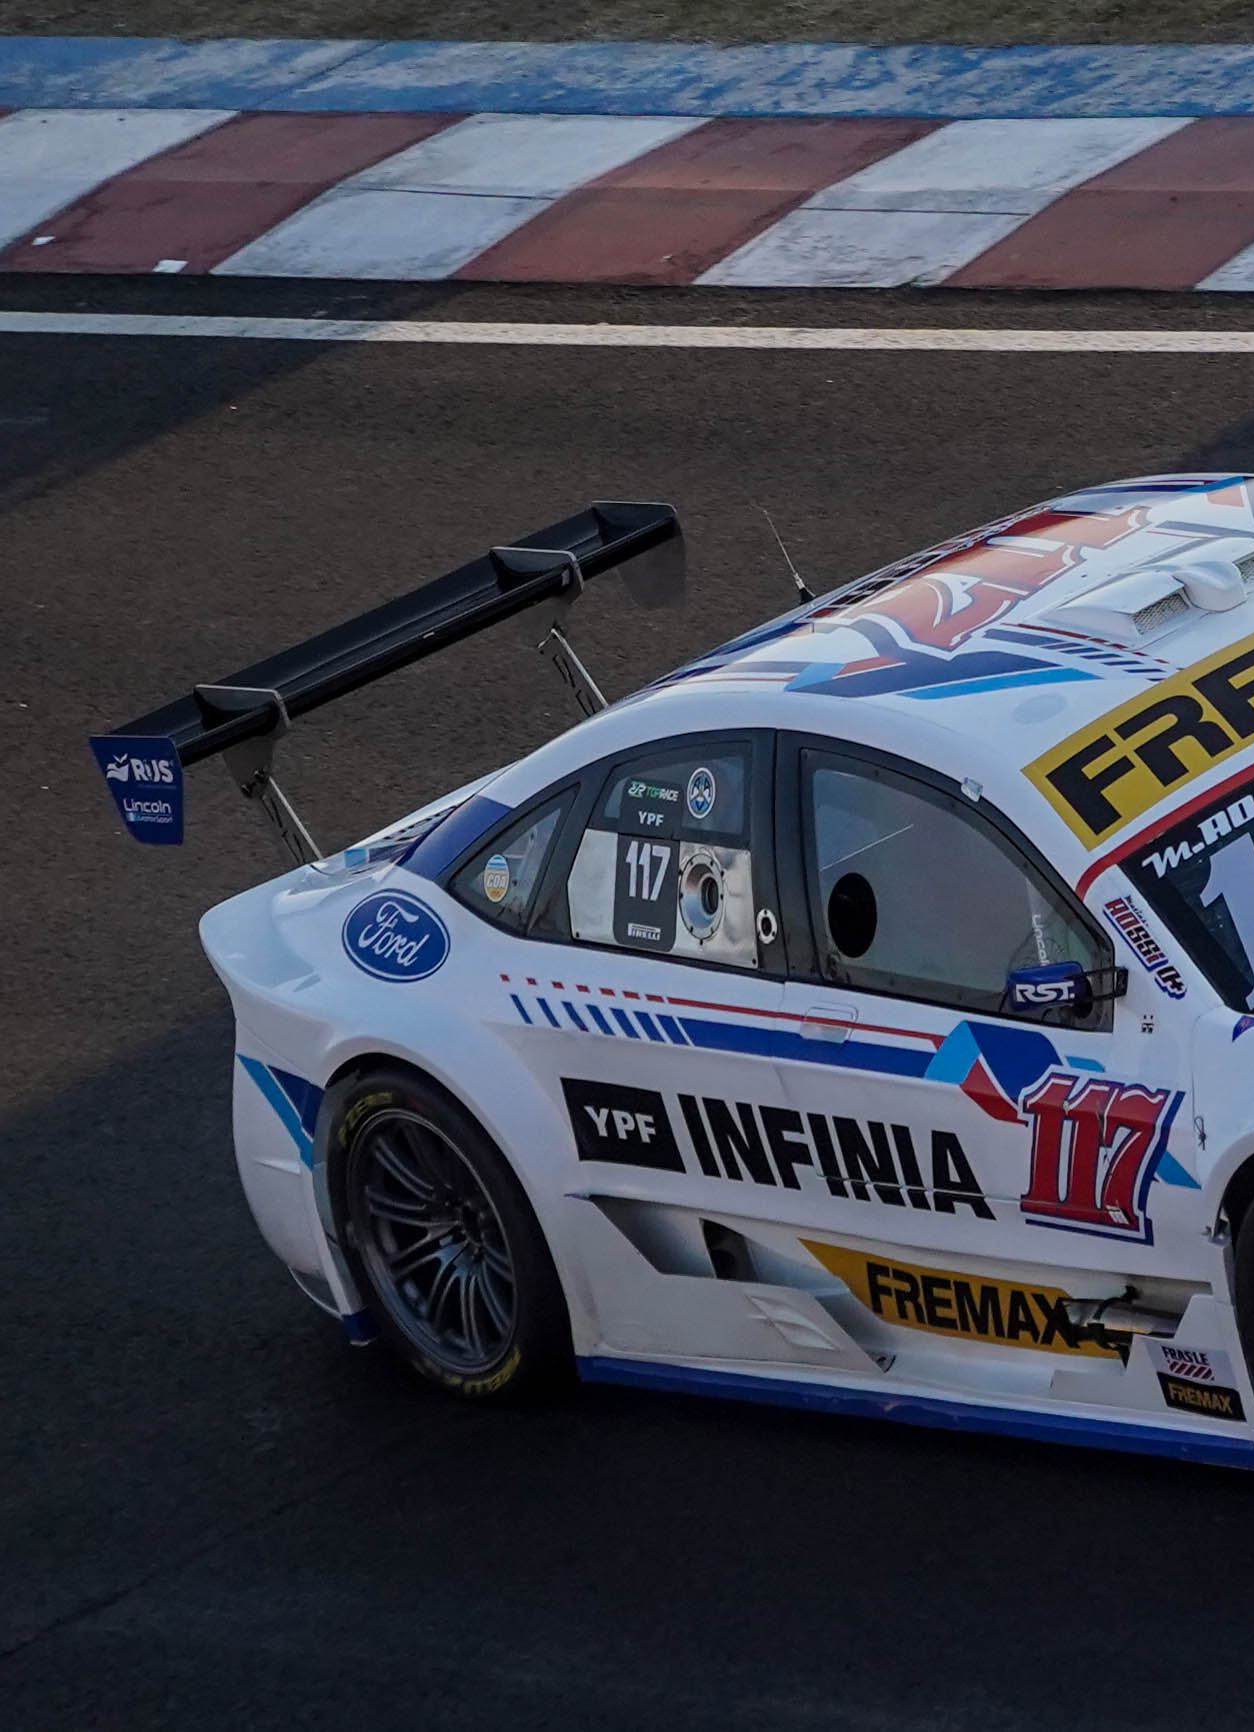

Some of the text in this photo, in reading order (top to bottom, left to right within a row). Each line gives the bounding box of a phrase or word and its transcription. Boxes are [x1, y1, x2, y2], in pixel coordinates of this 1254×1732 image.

[123, 798, 172, 814] Lincoln
[638, 810, 665, 826] YPF
[626, 840, 672, 900] 117
[358, 901, 430, 967] Ford
[586, 1106, 657, 1145] YPF
[677, 1093, 997, 1221] INFINIA
[1020, 1072, 1178, 1240] 117
[866, 1261, 1082, 1349] FREMAX
[1161, 1345, 1210, 1367] FRASLE
[1167, 1381, 1233, 1415] FREMAX
